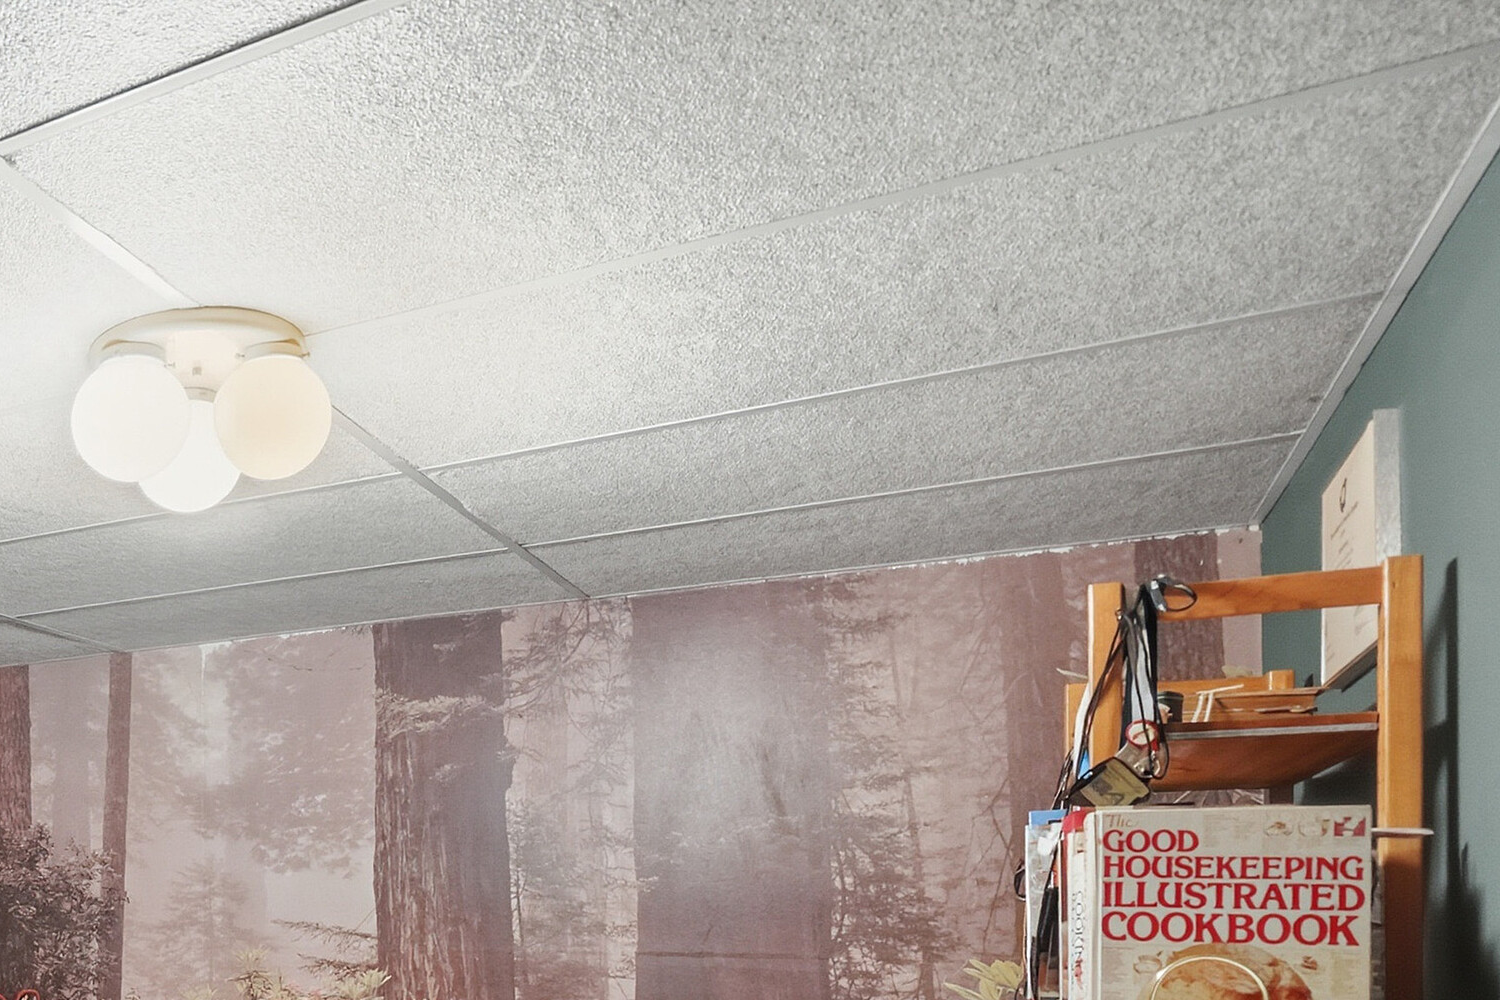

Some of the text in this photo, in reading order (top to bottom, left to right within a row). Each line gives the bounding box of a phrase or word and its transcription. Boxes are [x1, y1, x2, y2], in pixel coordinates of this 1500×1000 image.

[1102, 829, 1199, 853] GOOD
[1103, 856, 1363, 881] HOUSEKEEPING
[1102, 882, 1365, 911] ILLUSTRATED
[1102, 911, 1360, 946] COOKBOOK
